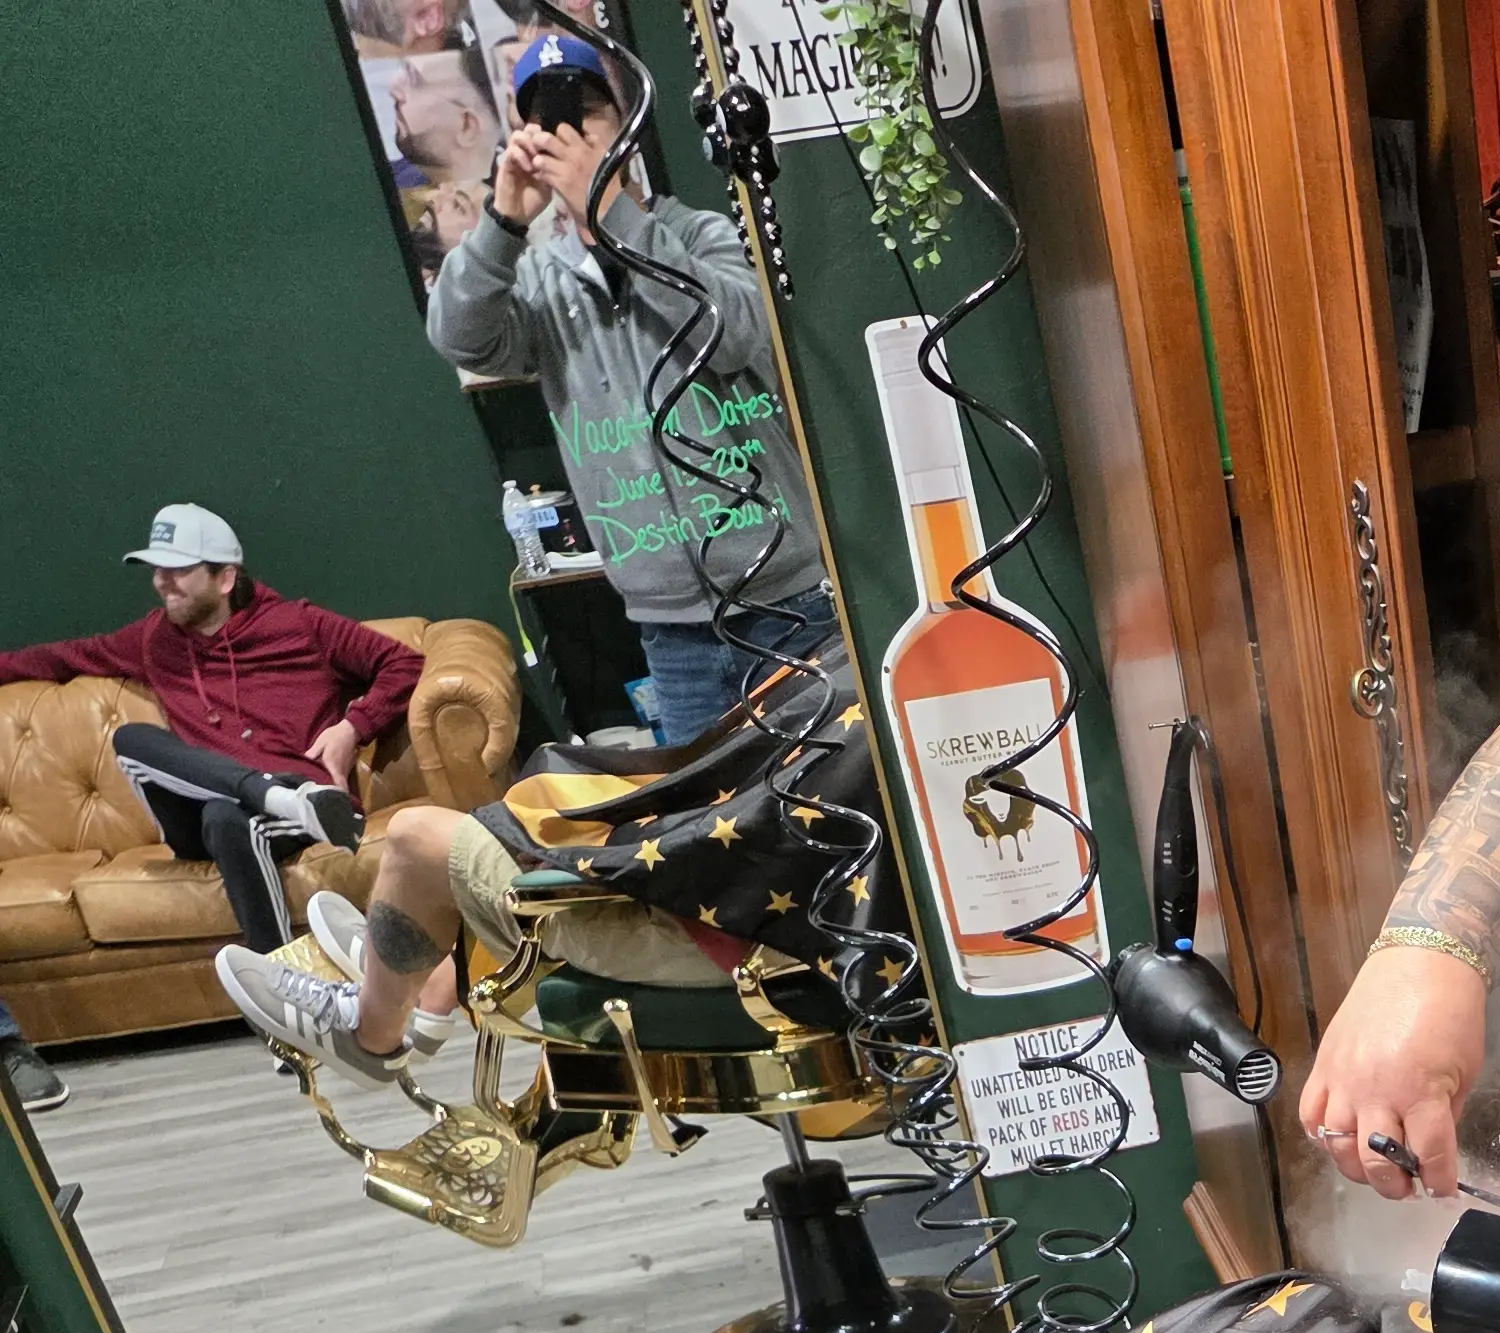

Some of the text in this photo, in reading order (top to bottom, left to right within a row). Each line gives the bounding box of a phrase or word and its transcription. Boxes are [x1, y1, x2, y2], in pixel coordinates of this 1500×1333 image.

[549, 382, 784, 467] Vacatin Dates:
[596, 466, 665, 508] June
[586, 510, 701, 568] Destin
[1013, 1025, 1080, 1061] NOTICE
[971, 1064, 1062, 1099] UNATTENDED
[997, 1096, 1035, 1119] WILL
[1039, 1089, 1055, 1111] BE
[1060, 1081, 1103, 1106] GIVEN
[989, 1119, 1028, 1147] PACK
[1030, 1112, 1048, 1138] OF
[1052, 1109, 1090, 1133] REDS
[1069, 1126, 1128, 1154] HAIRC
